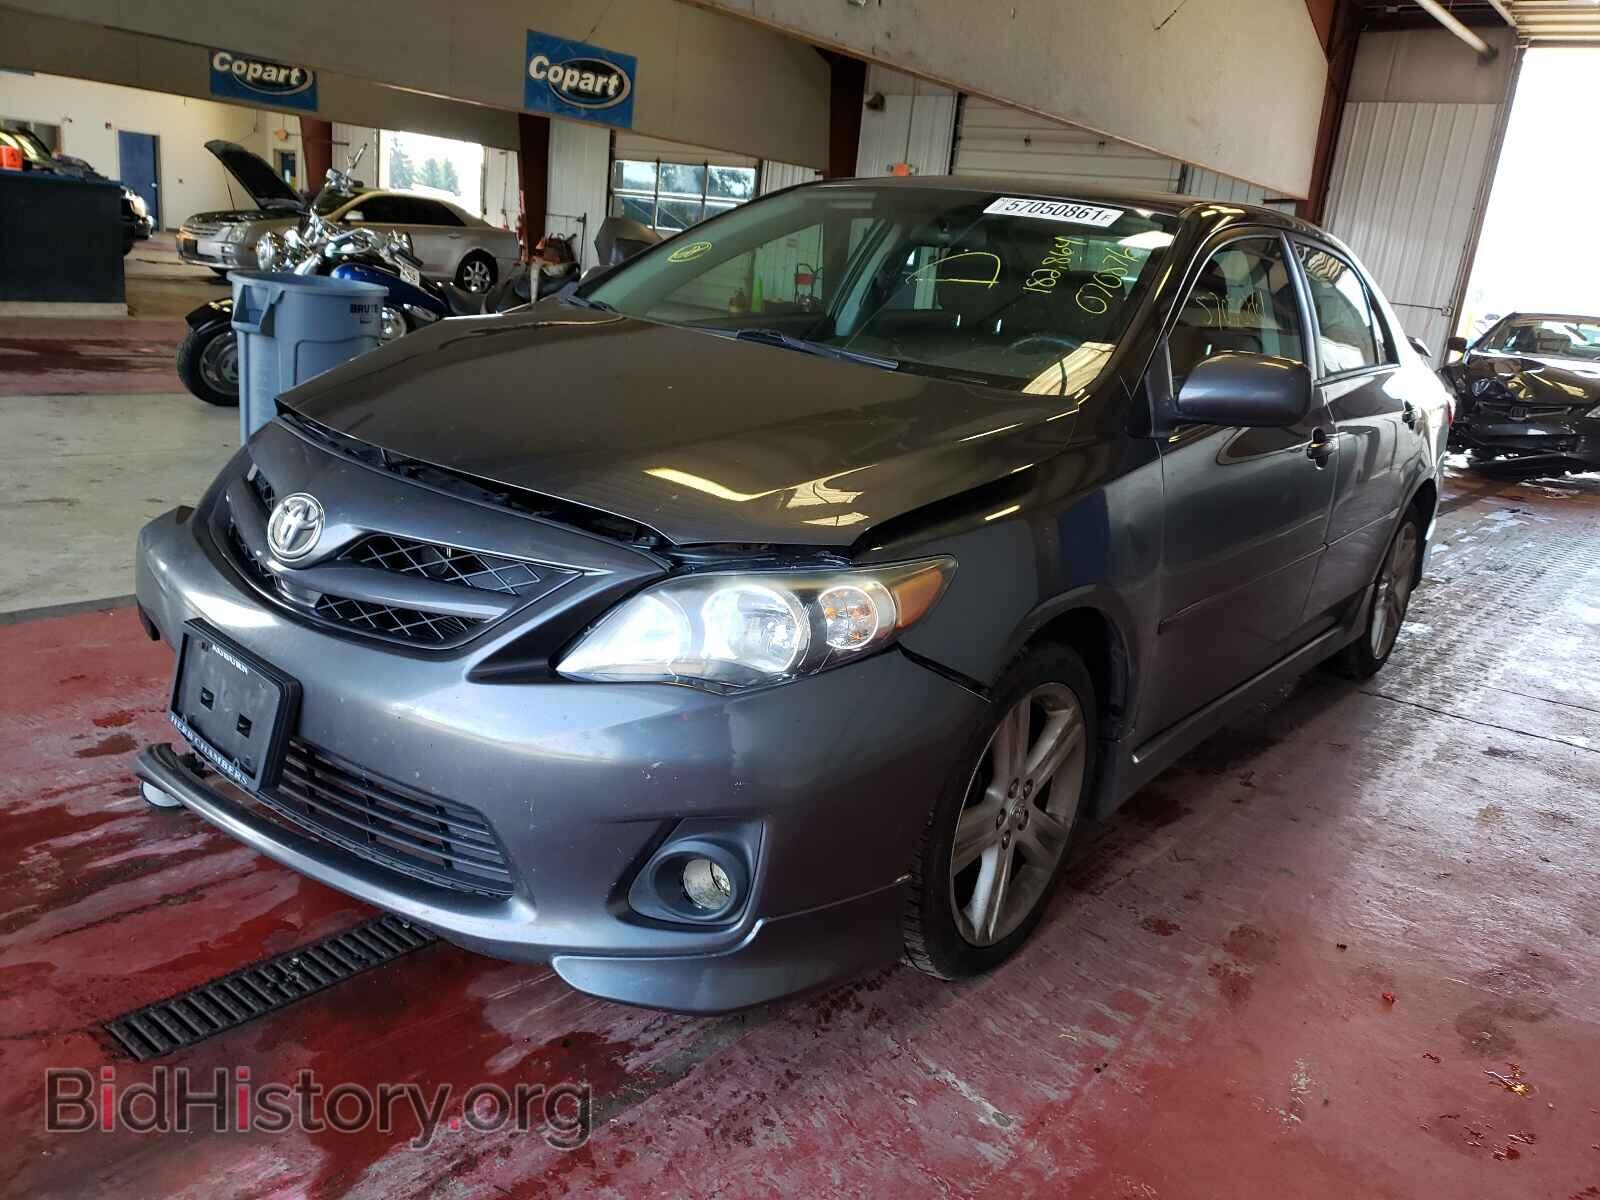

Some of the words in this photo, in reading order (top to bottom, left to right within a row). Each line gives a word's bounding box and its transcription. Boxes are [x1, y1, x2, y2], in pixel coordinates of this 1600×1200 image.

[213, 51, 300, 86] Copart
[528, 55, 619, 97] Copart
[1005, 201, 1104, 221] 57050861
[350, 303, 379, 314] BRUTE
[193, 736, 249, 785] CHAMBERS
